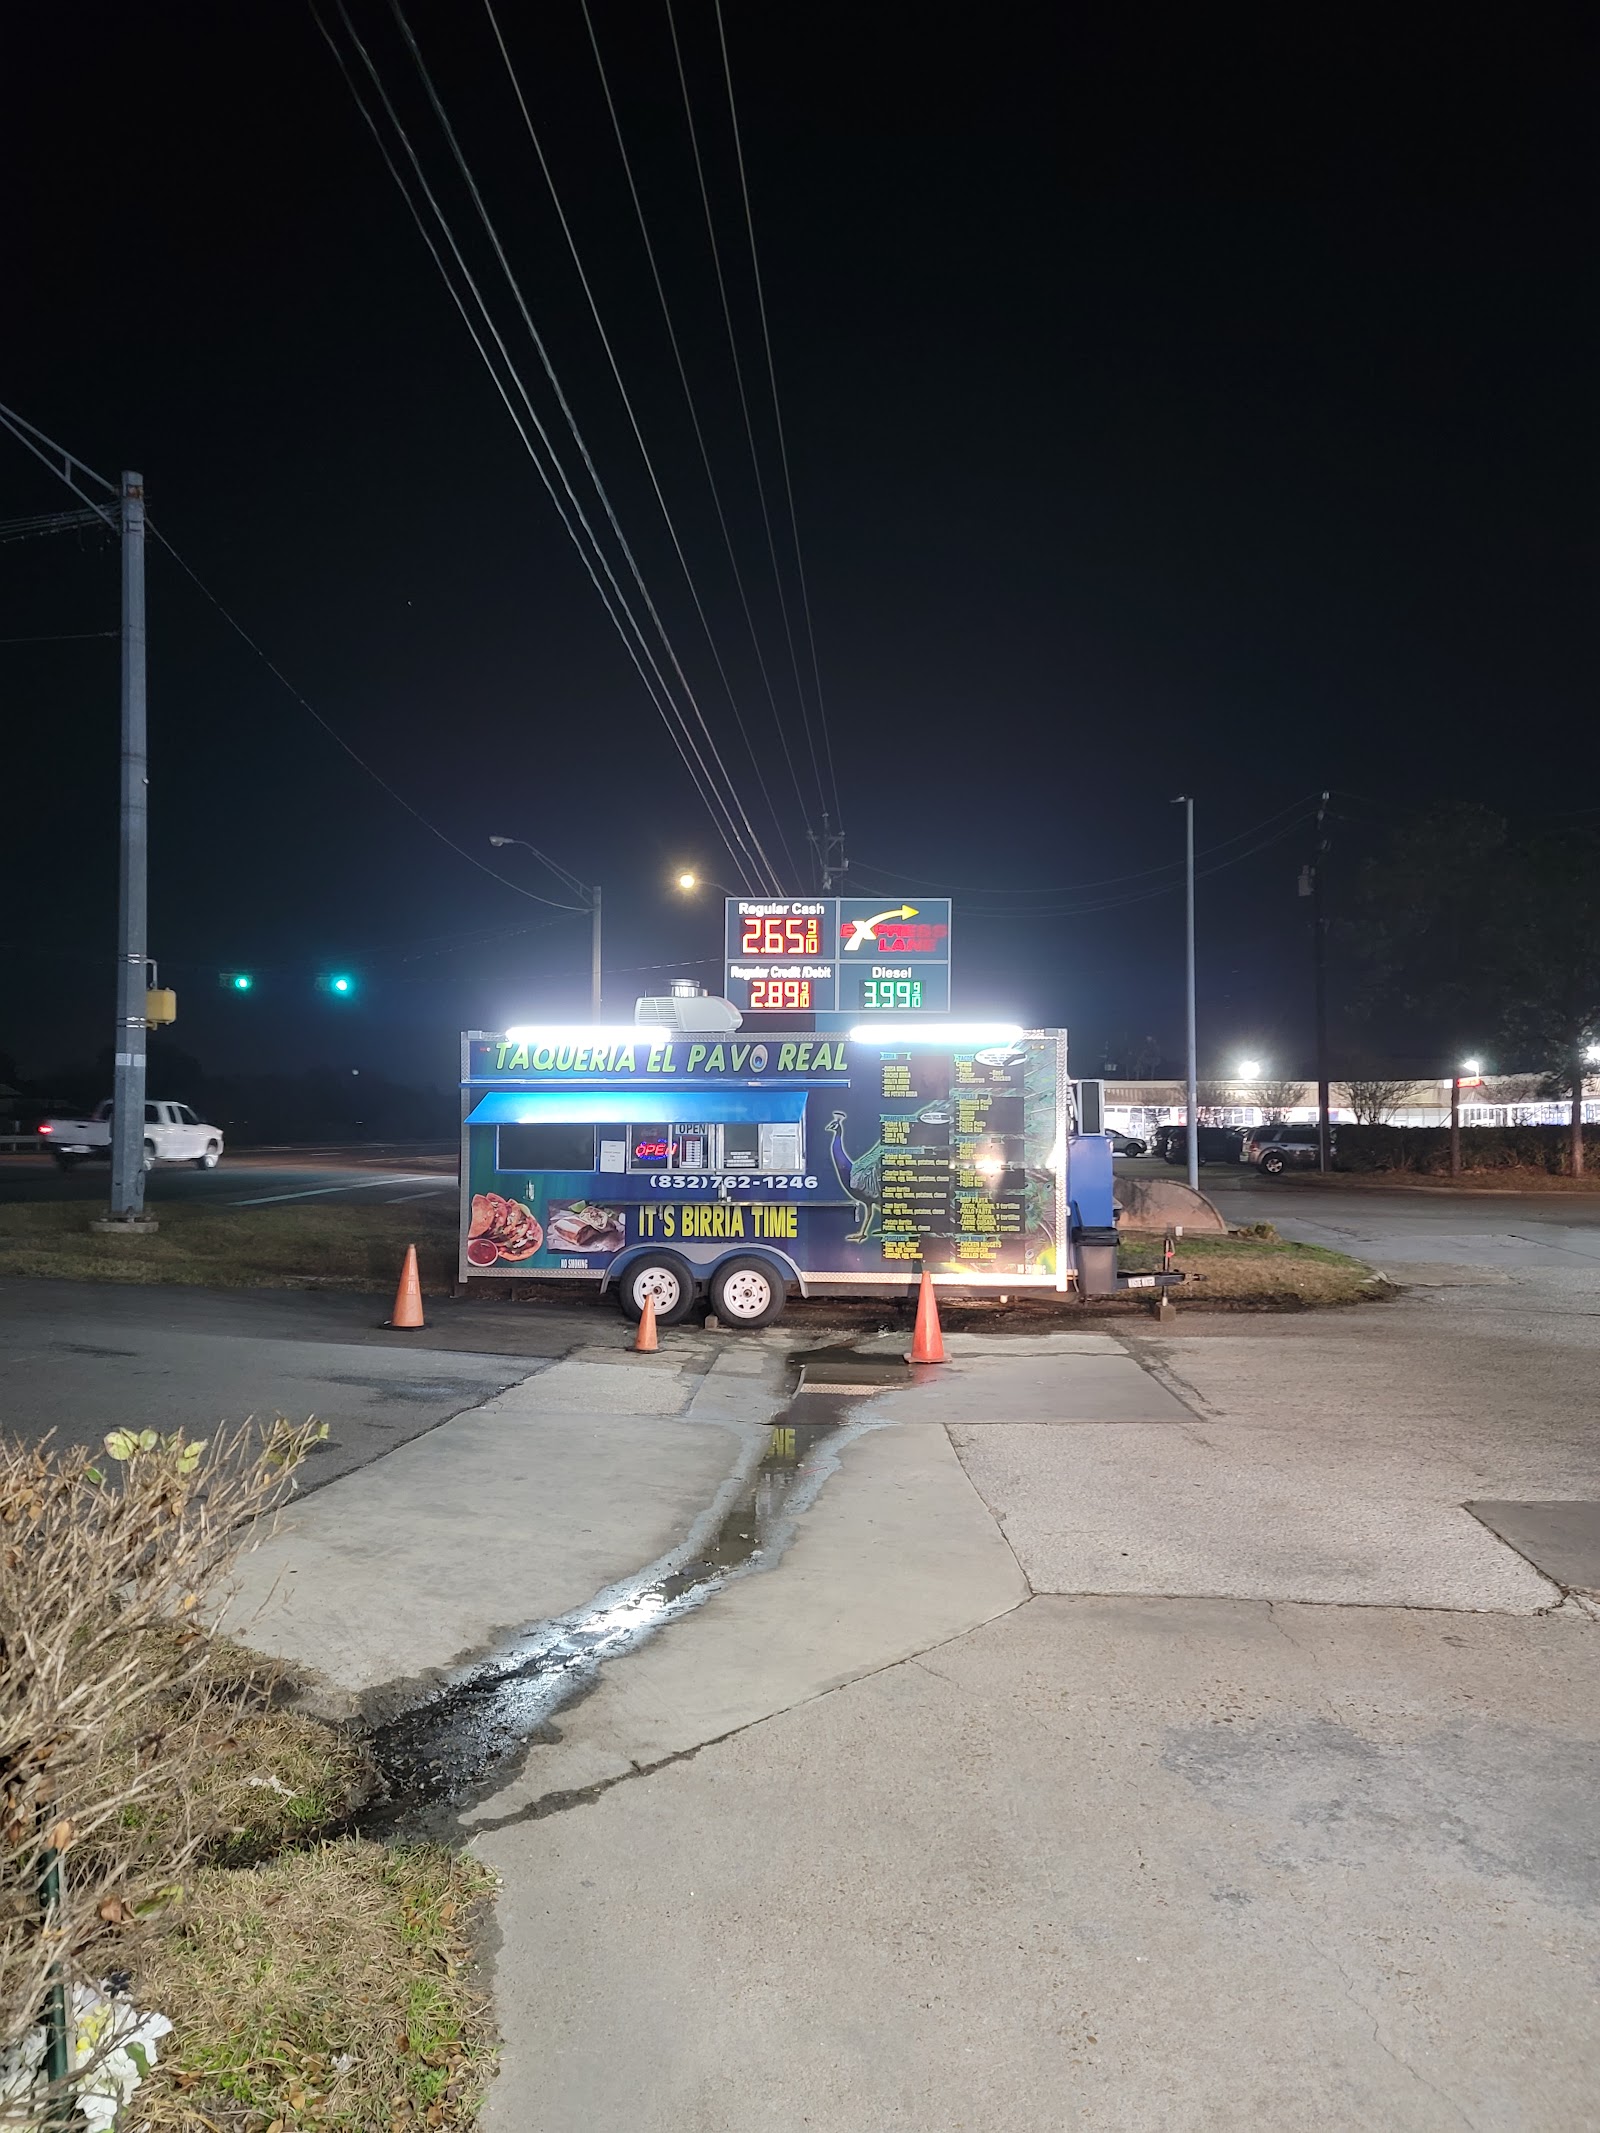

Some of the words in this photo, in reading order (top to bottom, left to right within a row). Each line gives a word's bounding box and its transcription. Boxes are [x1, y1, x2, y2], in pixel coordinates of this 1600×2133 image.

[738, 903, 790, 917] Regular
[792, 903, 825, 915] Cash
[742, 919, 804, 953] 2.65
[878, 938, 937, 952] LANE
[731, 966, 768, 980] Regular
[770, 966, 801, 978] Credit
[872, 967, 912, 978] Diesel
[750, 981, 800, 1008] 2.89
[864, 981, 911, 1008] 3.99
[495, 1042, 636, 1072] TAQUERIA
[647, 1043, 676, 1072] EL
[777, 1043, 848, 1072] REAL
[679, 1124, 706, 1134] OPEN
[635, 1142, 678, 1157] OPEN
[650, 1175, 818, 1190] (832)762-1246
[681, 1205, 745, 1237] BIRRIA
[751, 1206, 798, 1238] TIME
[561, 1259, 568, 1268] NO
[568, 1259, 588, 1268] SMOKING
